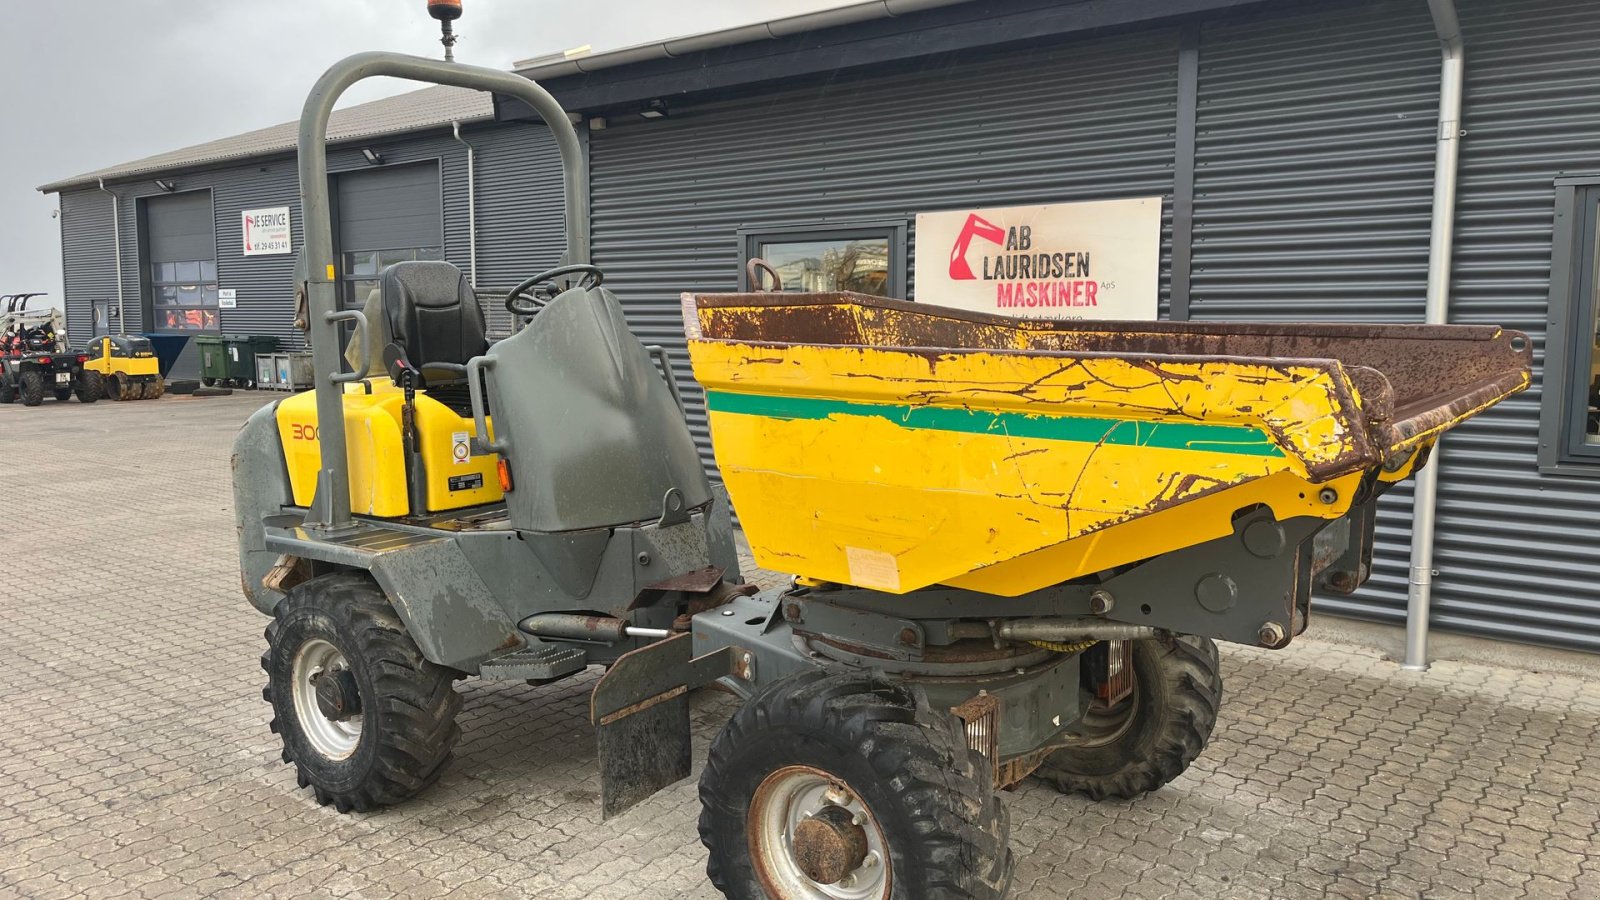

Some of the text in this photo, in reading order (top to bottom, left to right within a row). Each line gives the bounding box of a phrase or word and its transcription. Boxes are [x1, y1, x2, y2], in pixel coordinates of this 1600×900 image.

[254, 213, 286, 228] JE SERVICE
[1006, 225, 1031, 251] AB
[983, 251, 1090, 281] LAURIDSEN
[996, 280, 1116, 308] MASKINER ApS
